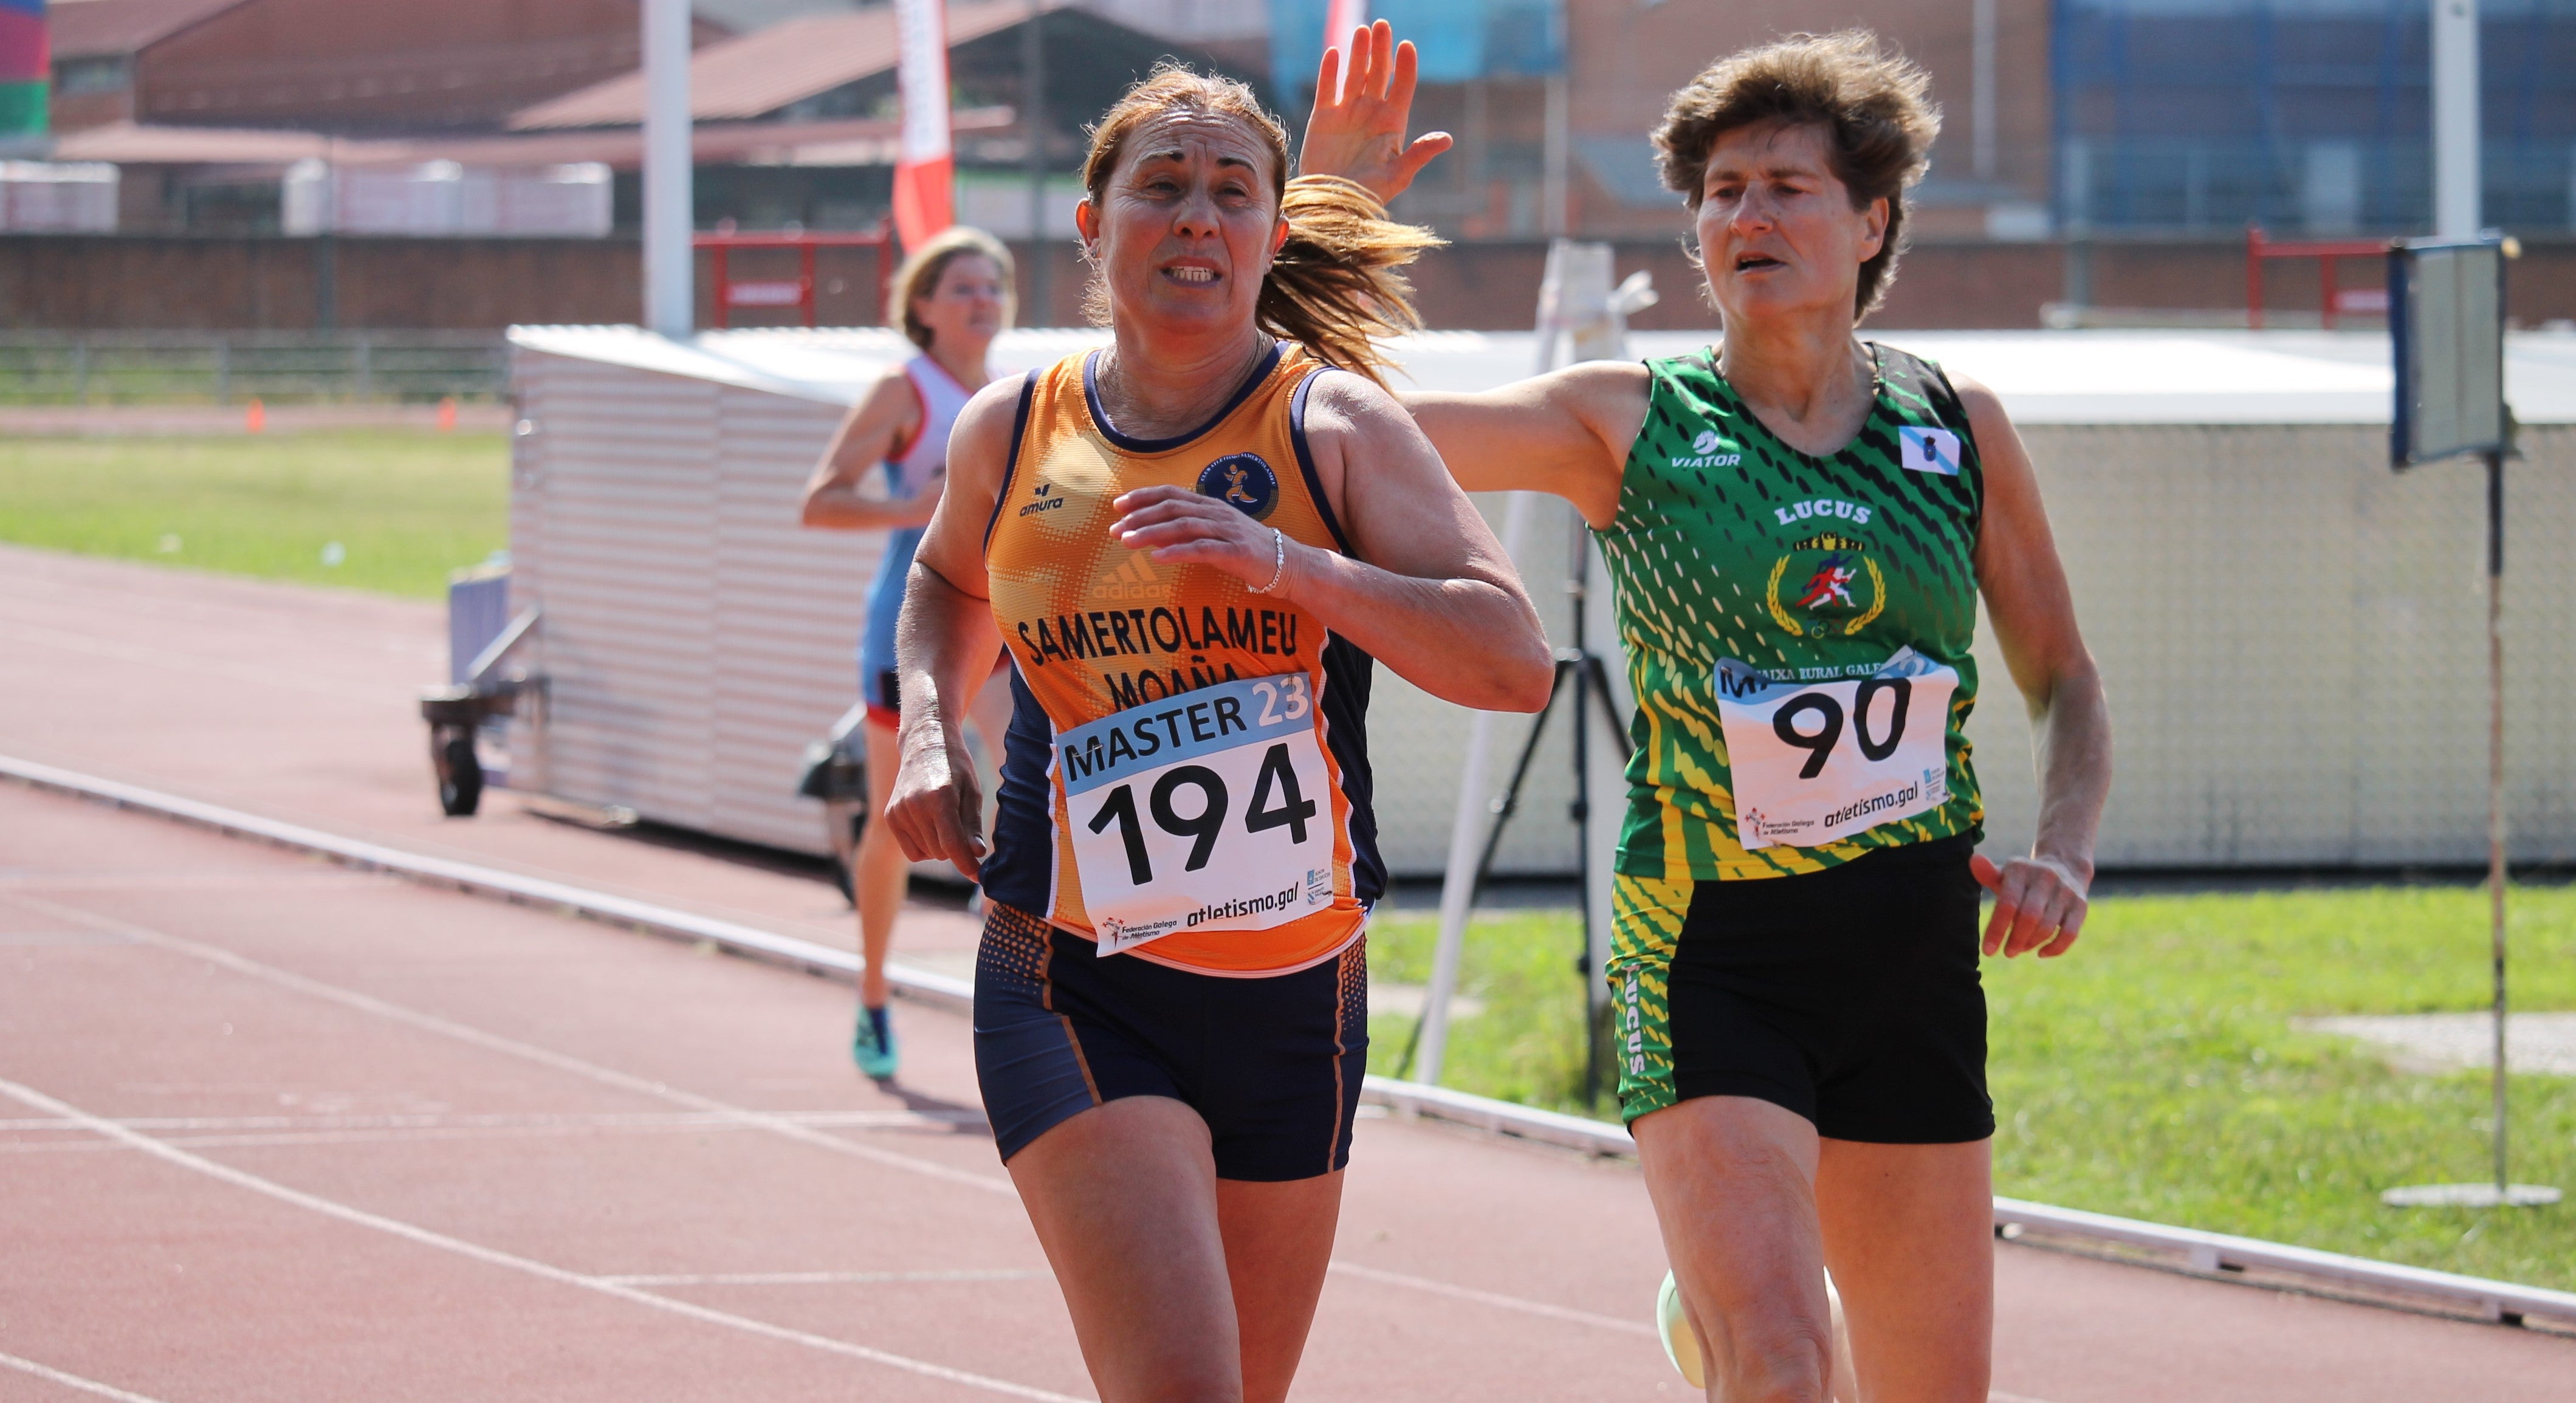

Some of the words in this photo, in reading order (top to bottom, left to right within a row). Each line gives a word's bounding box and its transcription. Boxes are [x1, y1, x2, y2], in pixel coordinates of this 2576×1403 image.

[1200, 467, 1211, 481] CLUB
[1671, 454, 1741, 468] VIATOR
[1020, 497, 1064, 517] amura
[1774, 499, 1872, 526] LUCUS
[1093, 581, 1171, 599] adidas
[1017, 606, 1297, 667] SAMERTOLAMEU
[1757, 668, 1796, 681] AIXA
[1846, 662, 1883, 676] GALE
[1065, 696, 1248, 783] MASTER
[1252, 676, 1309, 727] 23
[1773, 678, 1912, 779] 90
[1088, 743, 1316, 886] 194
[1824, 781, 1918, 828] atletismo.gal
[1187, 881, 1299, 927] atletismo.gal
